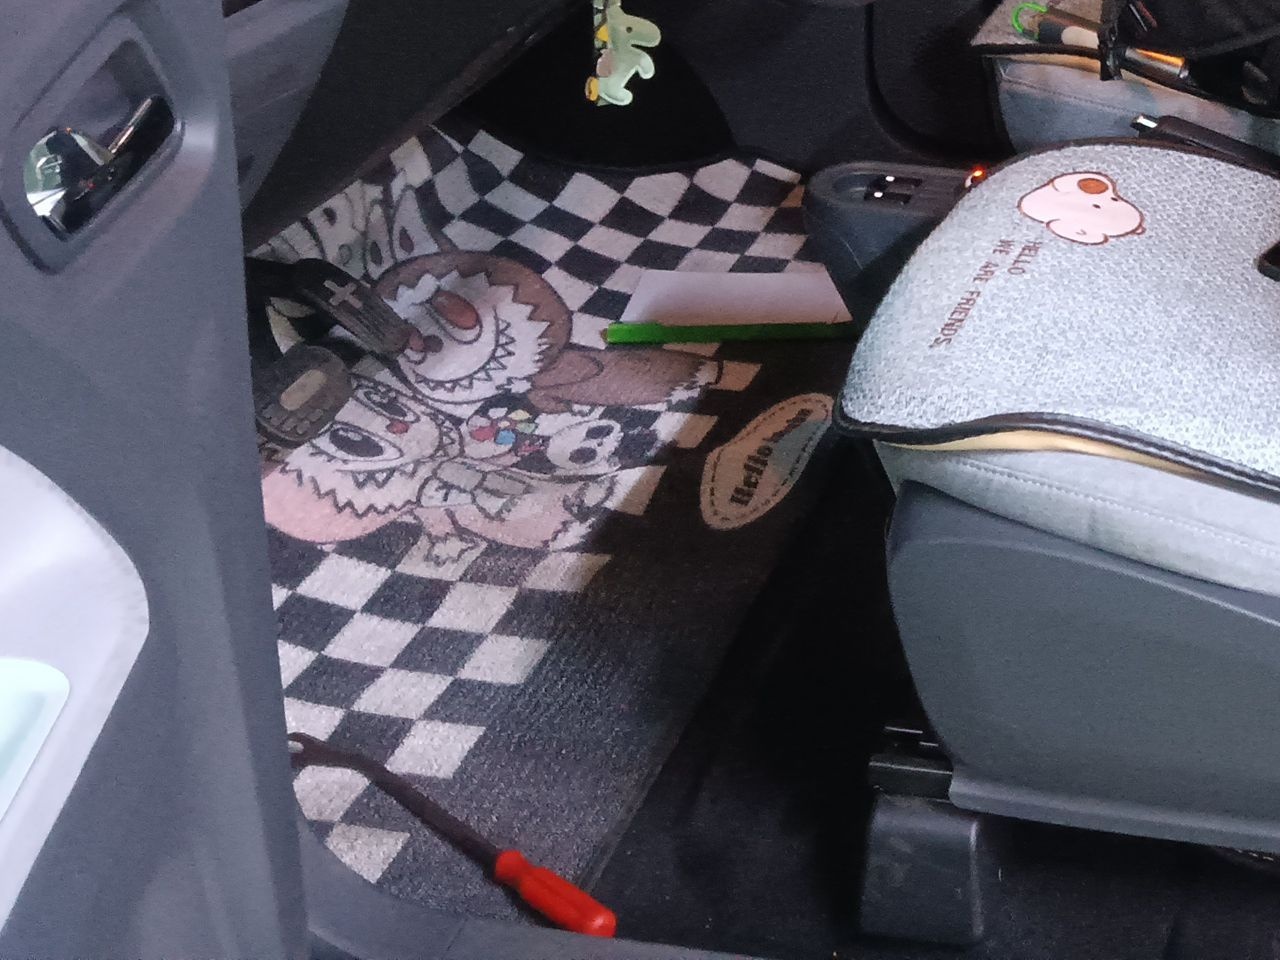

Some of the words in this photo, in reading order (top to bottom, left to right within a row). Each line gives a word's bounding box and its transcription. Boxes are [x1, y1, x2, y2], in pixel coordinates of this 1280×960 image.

[992, 239, 1015, 256] WE
[1007, 240, 1043, 276] HELLO
[972, 260, 999, 283] ARE
[729, 444, 773, 507] Hello
